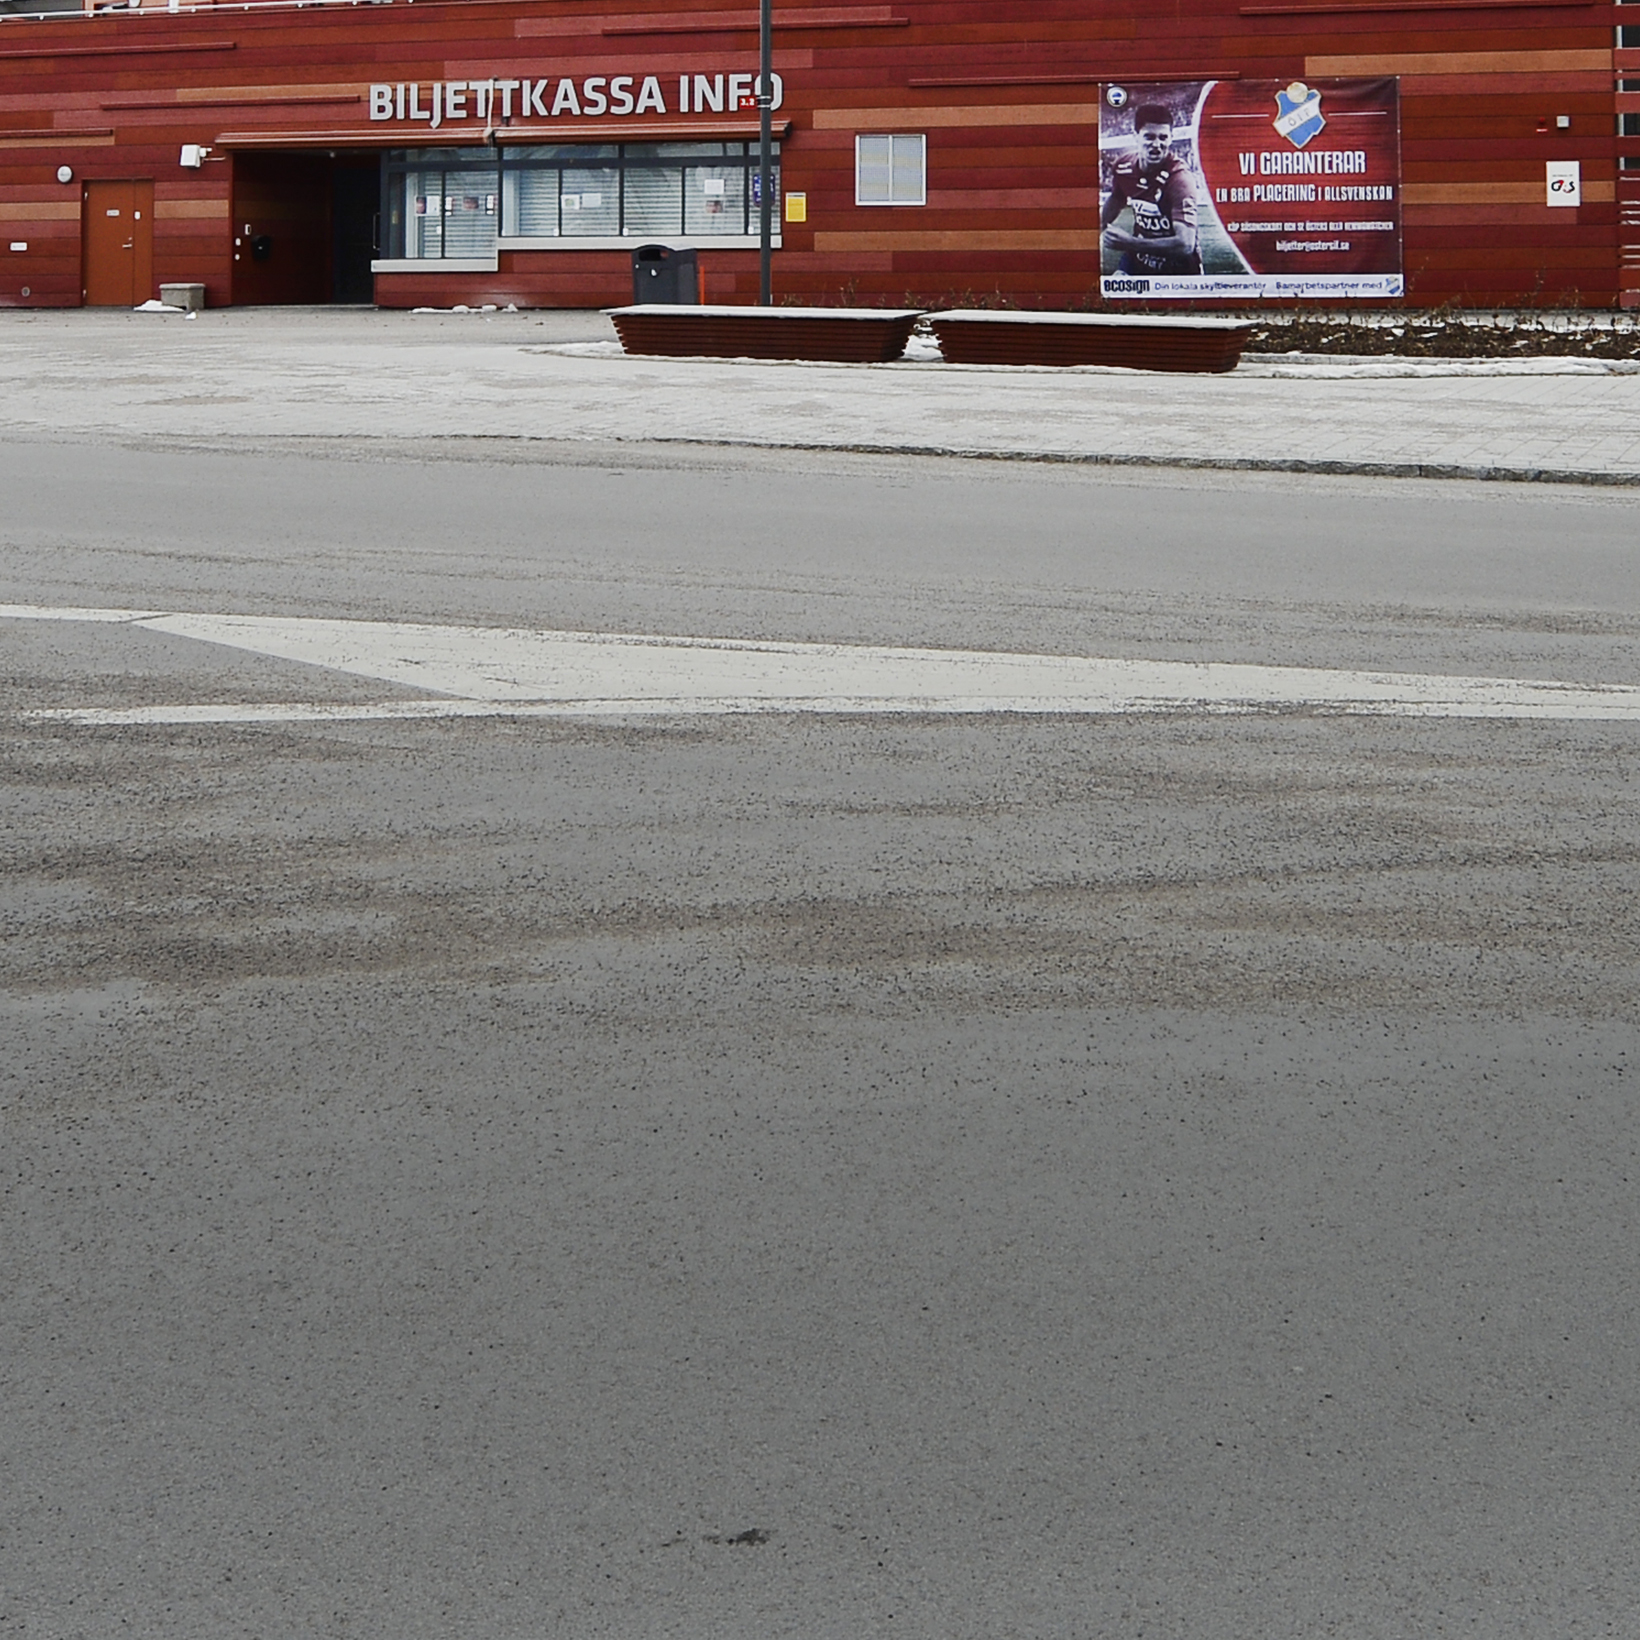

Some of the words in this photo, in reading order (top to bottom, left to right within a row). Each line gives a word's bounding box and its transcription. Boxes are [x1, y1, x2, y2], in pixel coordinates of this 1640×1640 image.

[369, 76, 666, 129] BILJETTKASSA
[679, 73, 783, 113] INFO
[1239, 152, 1255, 175] VI
[1260, 151, 1366, 175] GARANTERAR
[1253, 184, 1315, 202] PLACERING
[1324, 185, 1393, 201] ALLSVENSKAN
[1155, 282, 1169, 290] Din
[1172, 282, 1198, 290] lokala
[1362, 281, 1382, 289] med
